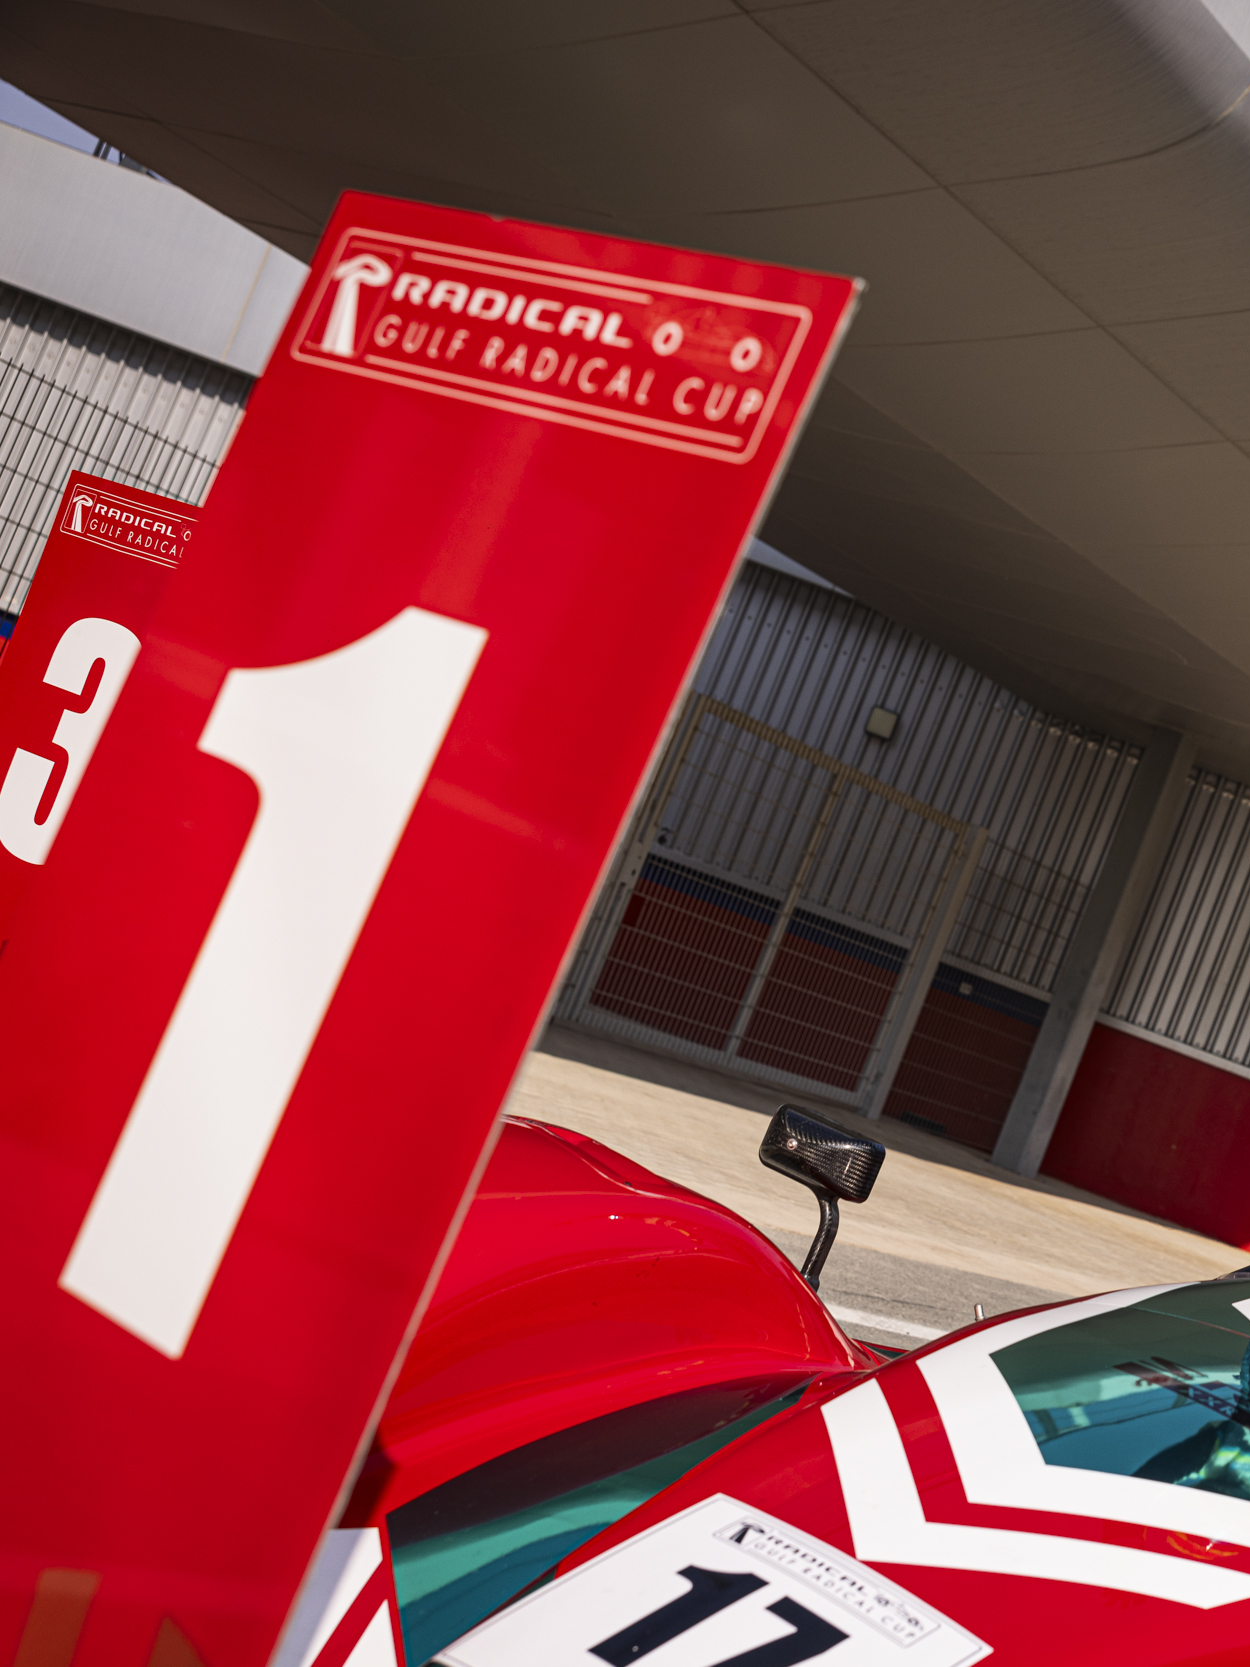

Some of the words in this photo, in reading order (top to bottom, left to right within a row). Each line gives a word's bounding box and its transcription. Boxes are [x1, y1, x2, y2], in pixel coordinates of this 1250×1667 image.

[391, 272, 633, 349] RADICAL
[373, 313, 470, 361] GULF
[479, 335, 656, 406] RADICAL
[671, 376, 764, 426] CUP
[90, 519, 122, 538] GULF
[127, 531, 184, 558] RADICAL
[95, 503, 176, 538] RADICAL
[0, 617, 142, 866] 3
[58, 606, 487, 1361] 1
[767, 1535, 868, 1597] RADICAL
[588, 1564, 850, 1667] 17
[881, 1615, 917, 1639] CUP
